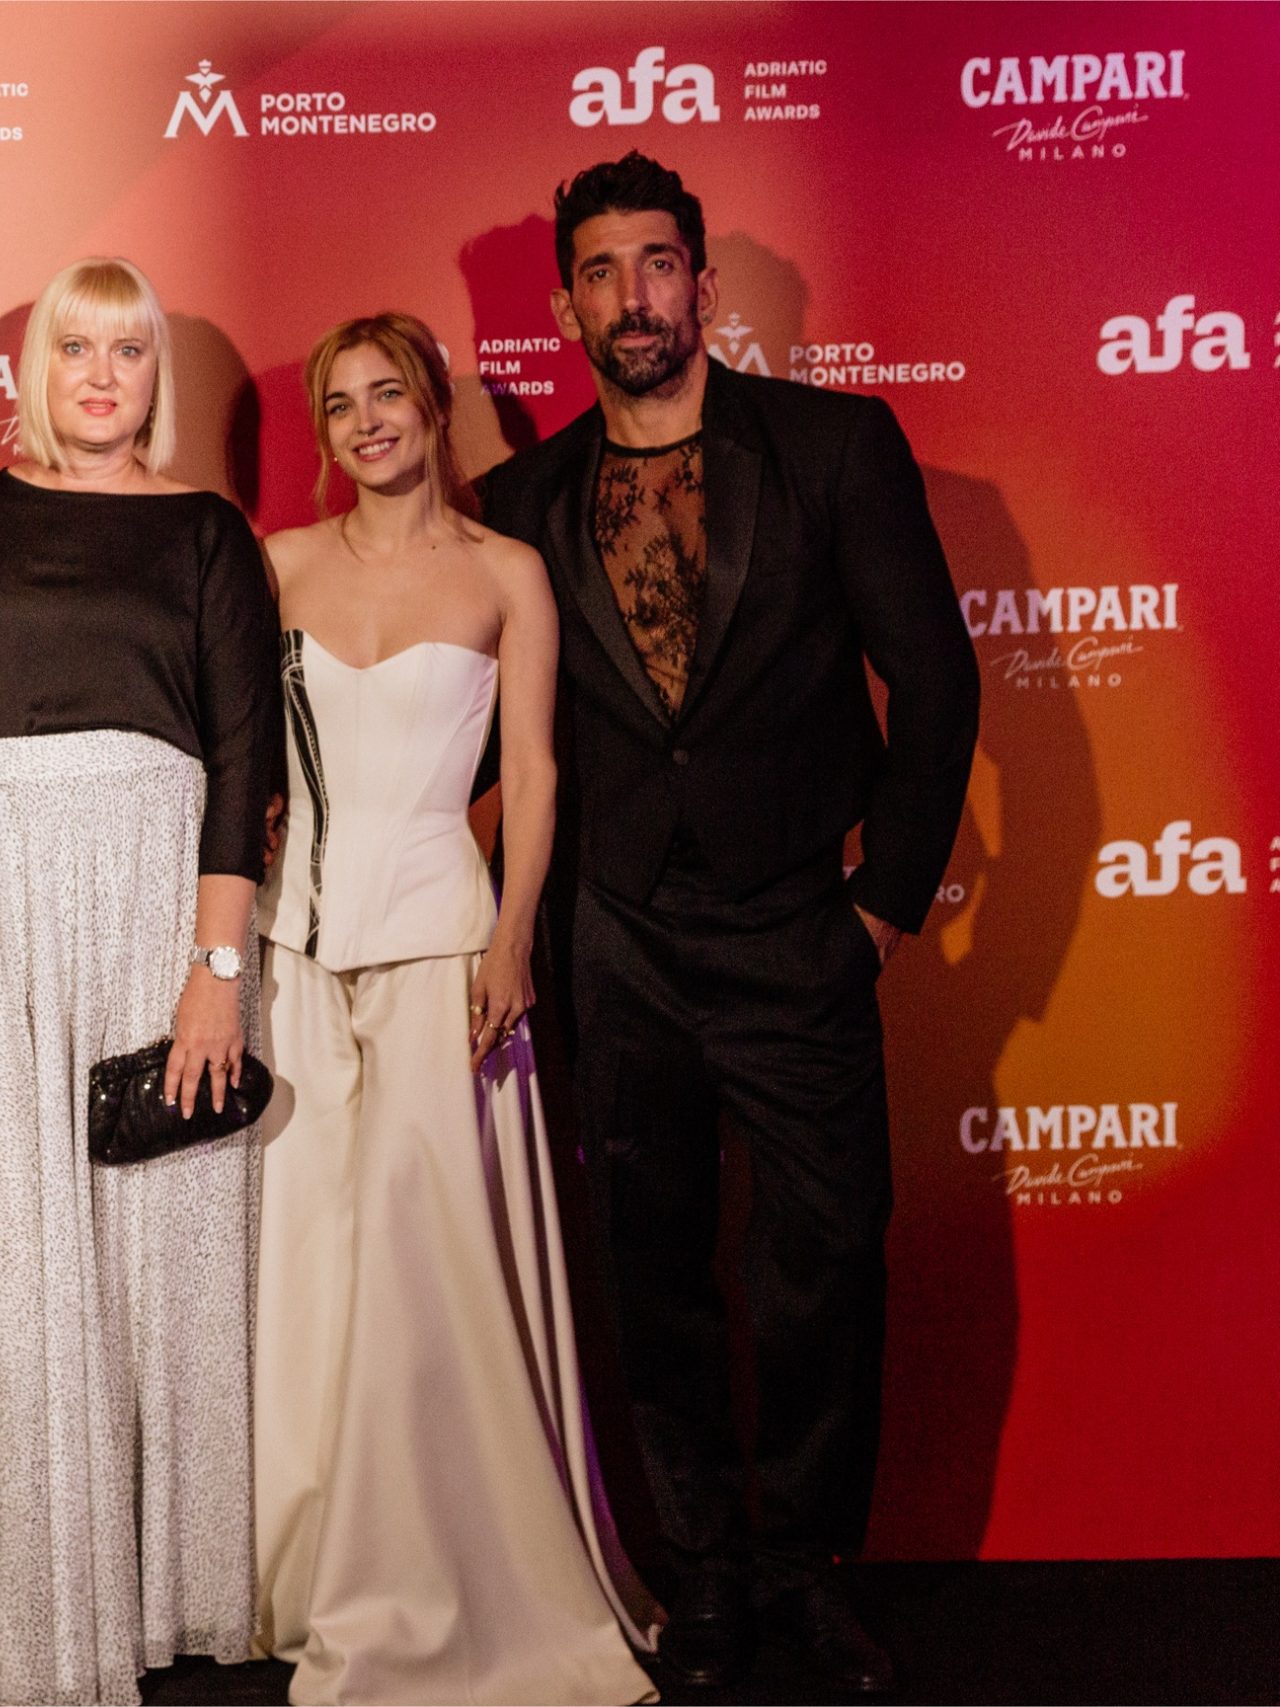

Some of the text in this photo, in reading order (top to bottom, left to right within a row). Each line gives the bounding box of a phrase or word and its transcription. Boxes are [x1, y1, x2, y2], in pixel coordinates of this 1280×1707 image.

[744, 60, 827, 78] ADRIATIC
[960, 49, 1186, 108] CAMPARI
[569, 46, 720, 127] afa
[744, 84, 786, 99] FILM
[260, 92, 345, 113] PORTO
[744, 105, 820, 121] AWARDS
[260, 113, 436, 136] MONTENEGRO
[1020, 144, 1126, 161] MILANO
[1096, 294, 1251, 375] afa
[479, 337, 561, 354] ADRIATIC
[790, 342, 875, 364] PORTO
[479, 360, 521, 375] FILM
[790, 361, 966, 386] MONTENEGRO
[480, 380, 555, 396] AWARDS
[959, 583, 1180, 638] CAMPARI
[1016, 673, 1122, 689] MILANO
[1094, 819, 1247, 899] afa
[958, 1102, 1179, 1154] CAMPARI
[1016, 1189, 1122, 1205] MILANO
